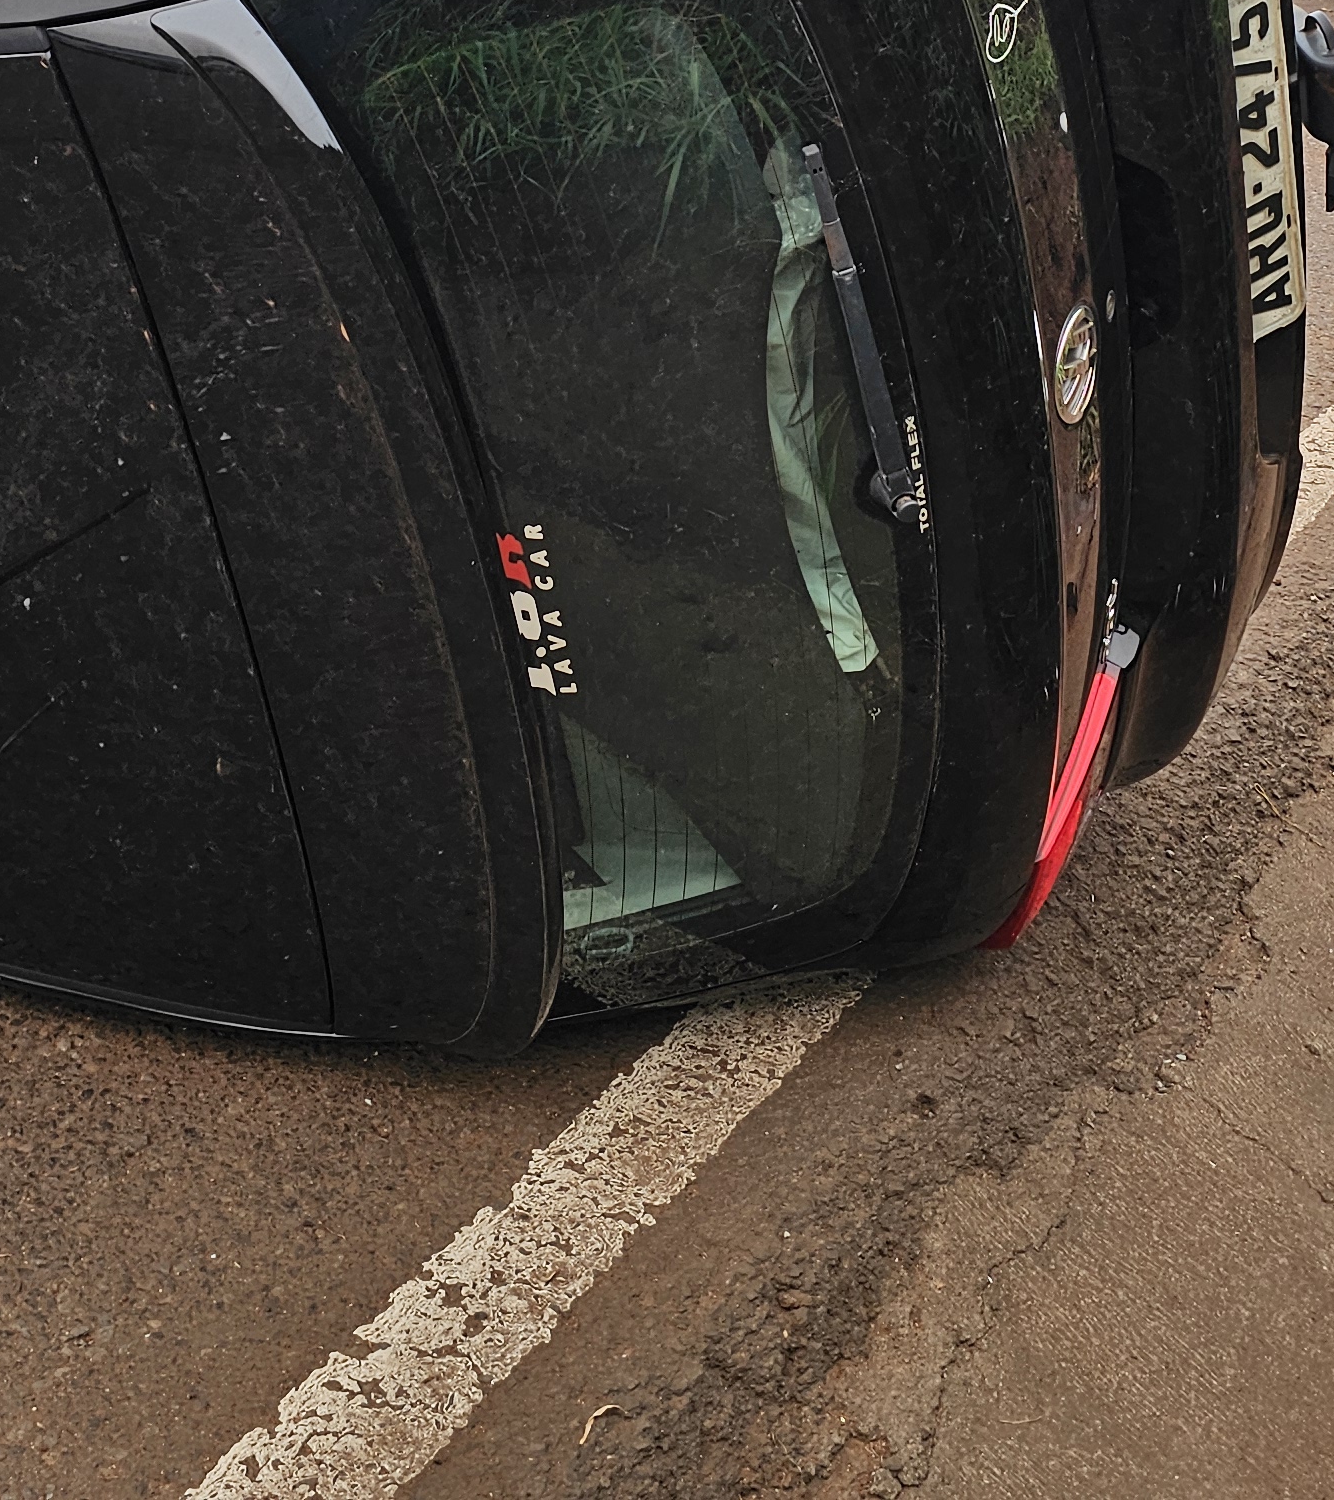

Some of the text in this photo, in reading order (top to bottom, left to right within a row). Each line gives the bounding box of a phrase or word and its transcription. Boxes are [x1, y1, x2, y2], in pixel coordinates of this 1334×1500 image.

[904, 415, 930, 534] TOTAL FLEX
[524, 522, 578, 695] LAVA CAR
